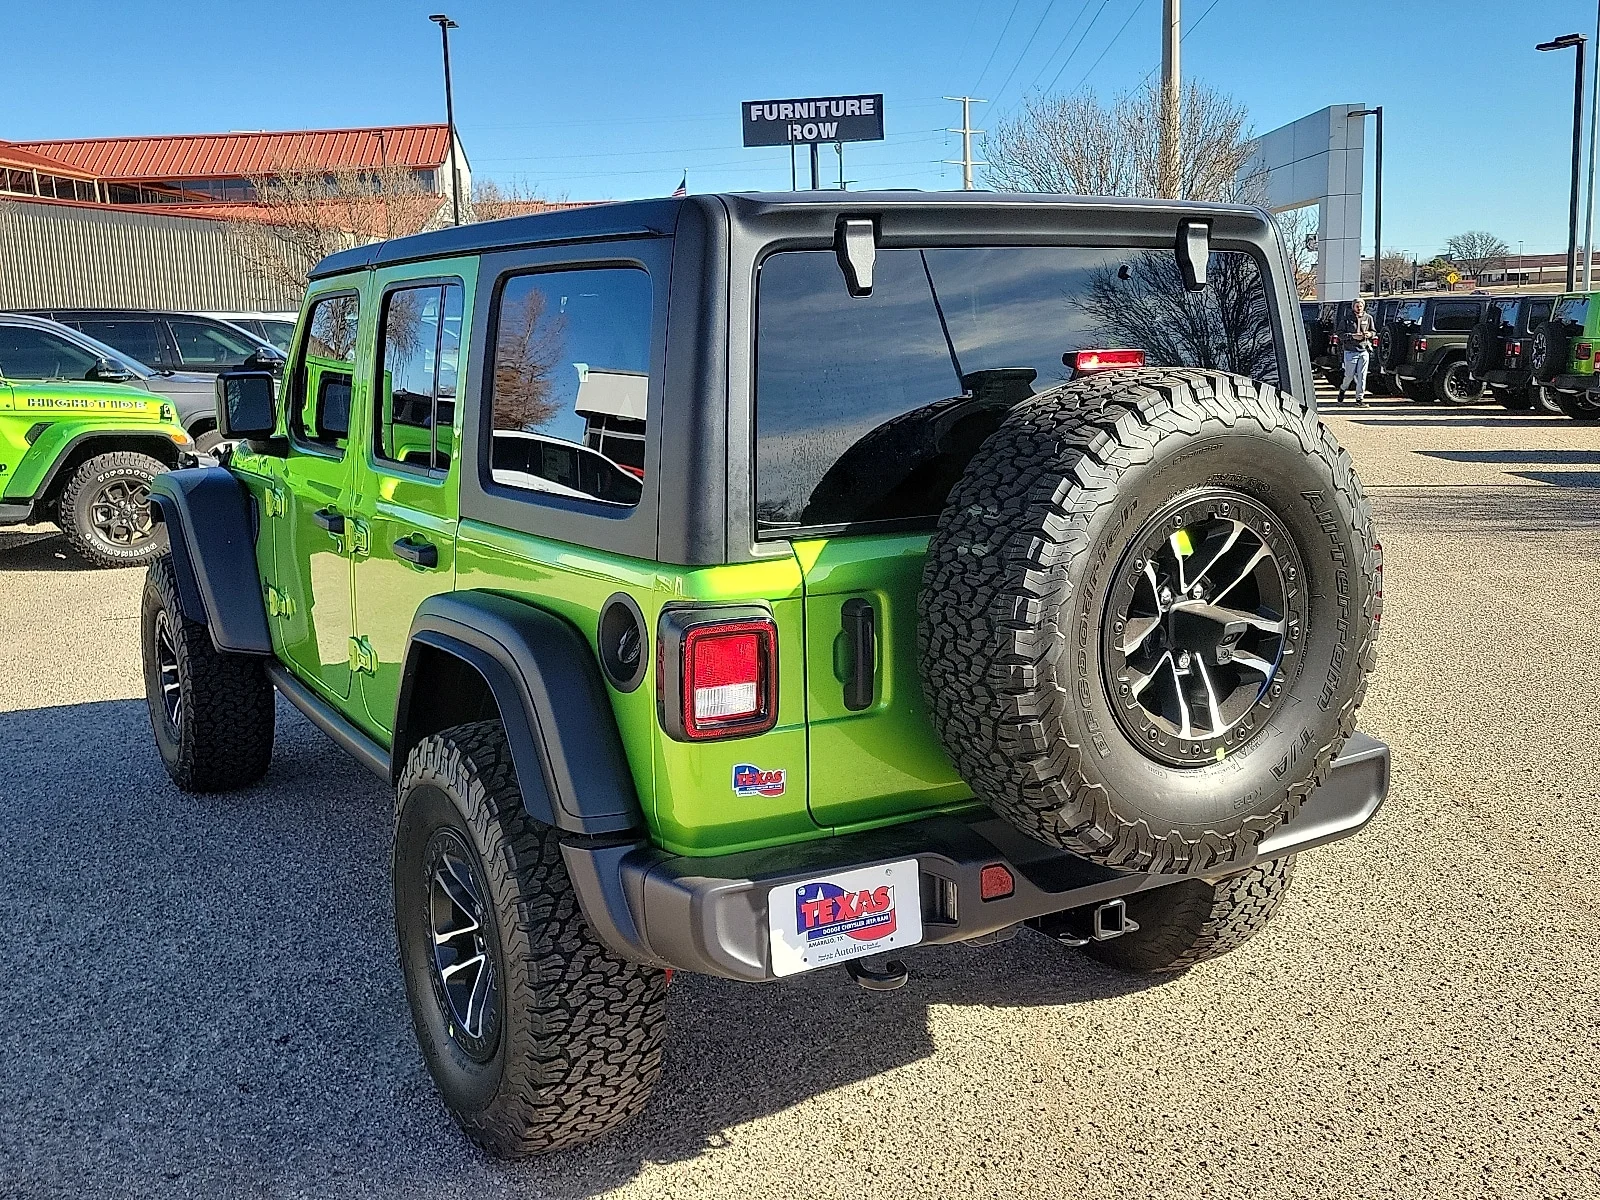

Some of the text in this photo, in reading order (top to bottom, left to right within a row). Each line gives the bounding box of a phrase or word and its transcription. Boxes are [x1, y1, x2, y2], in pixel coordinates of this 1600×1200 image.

[750, 98, 875, 122] FURNITURE
[788, 122, 838, 141] ROW
[27, 398, 89, 408] HIGH
[737, 769, 783, 786] TEXAS
[801, 885, 891, 928] TEXAS
[822, 926, 841, 935] DODGE
[841, 919, 865, 931] CHRYSLER
[834, 943, 867, 958] AutoInc
